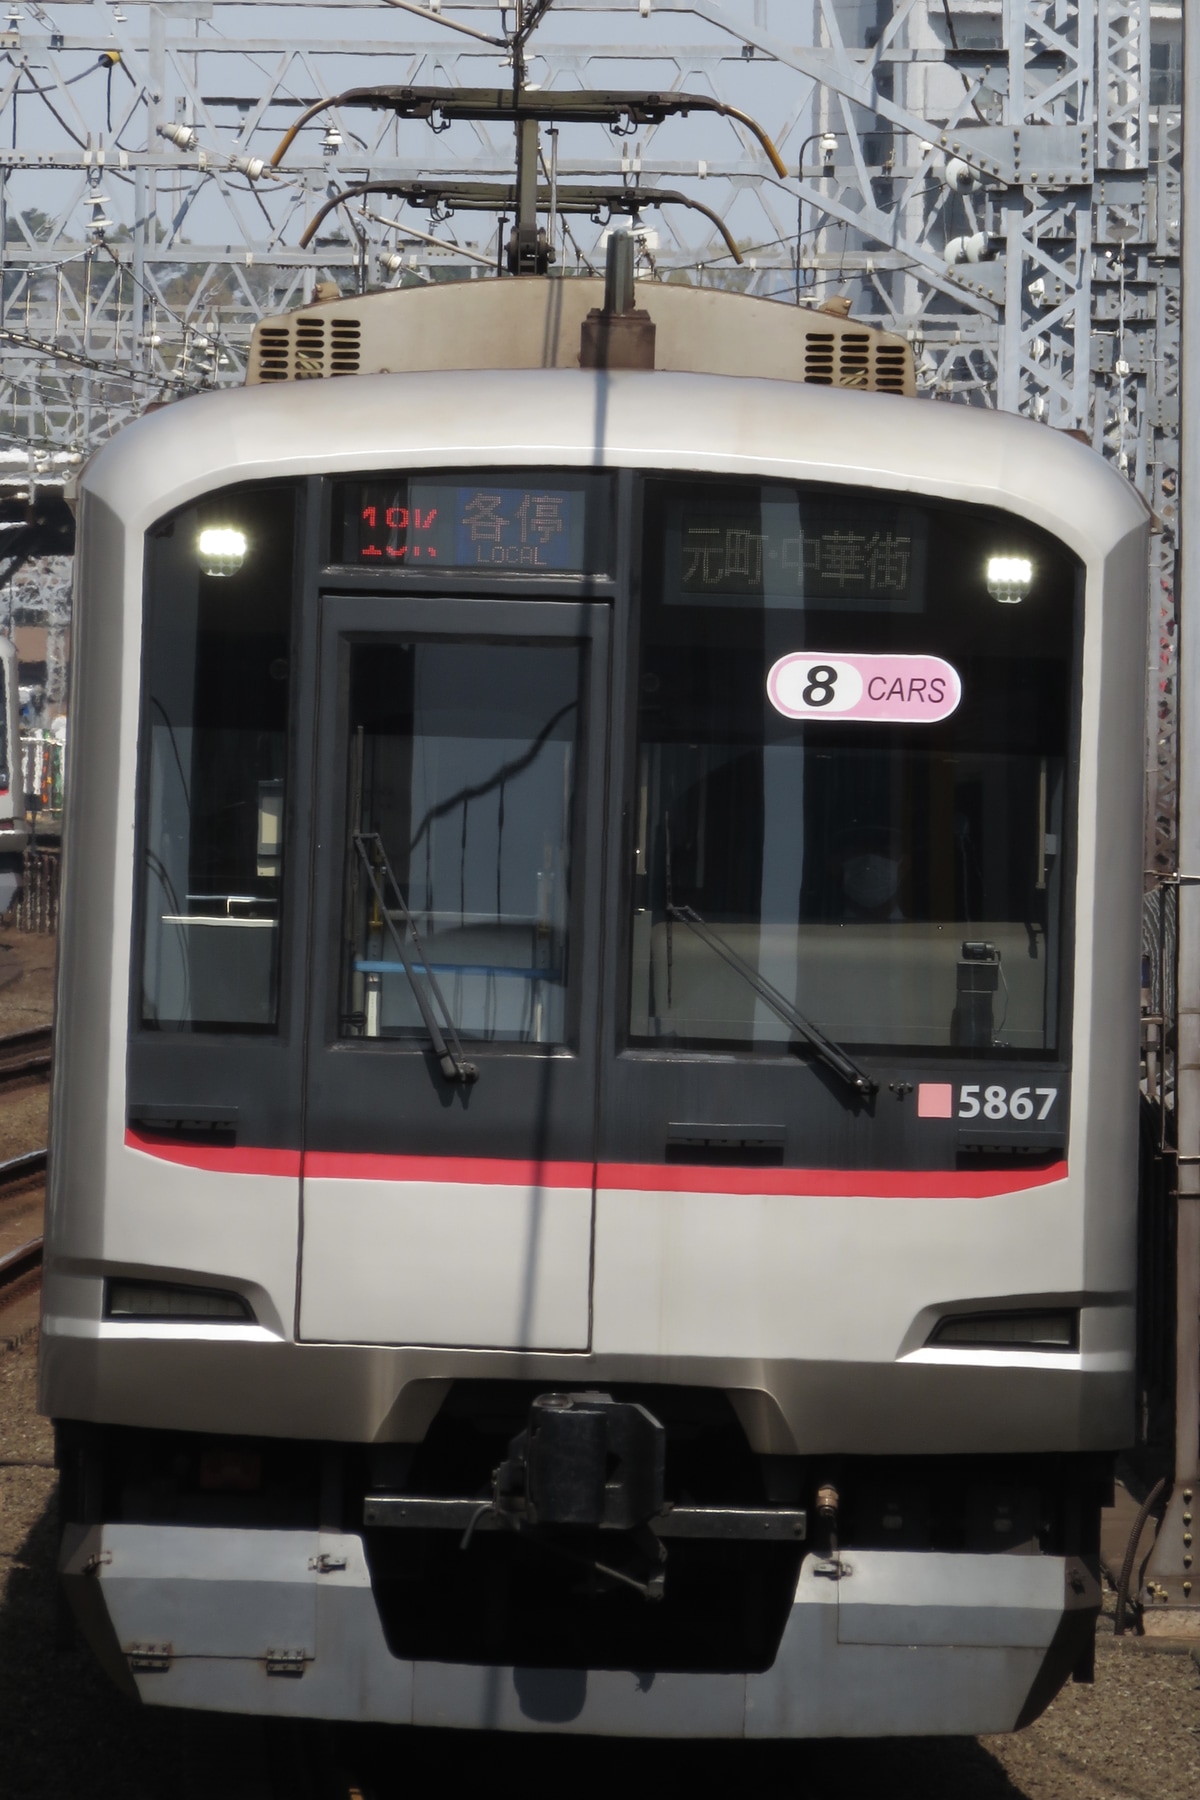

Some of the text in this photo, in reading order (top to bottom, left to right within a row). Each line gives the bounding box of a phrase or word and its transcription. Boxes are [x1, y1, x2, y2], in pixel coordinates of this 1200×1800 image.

[462, 493, 564, 544] 各停
[477, 545, 547, 565] LOCAL
[802, 665, 946, 707] 8 CARS
[958, 1085, 1058, 1120] 5867
